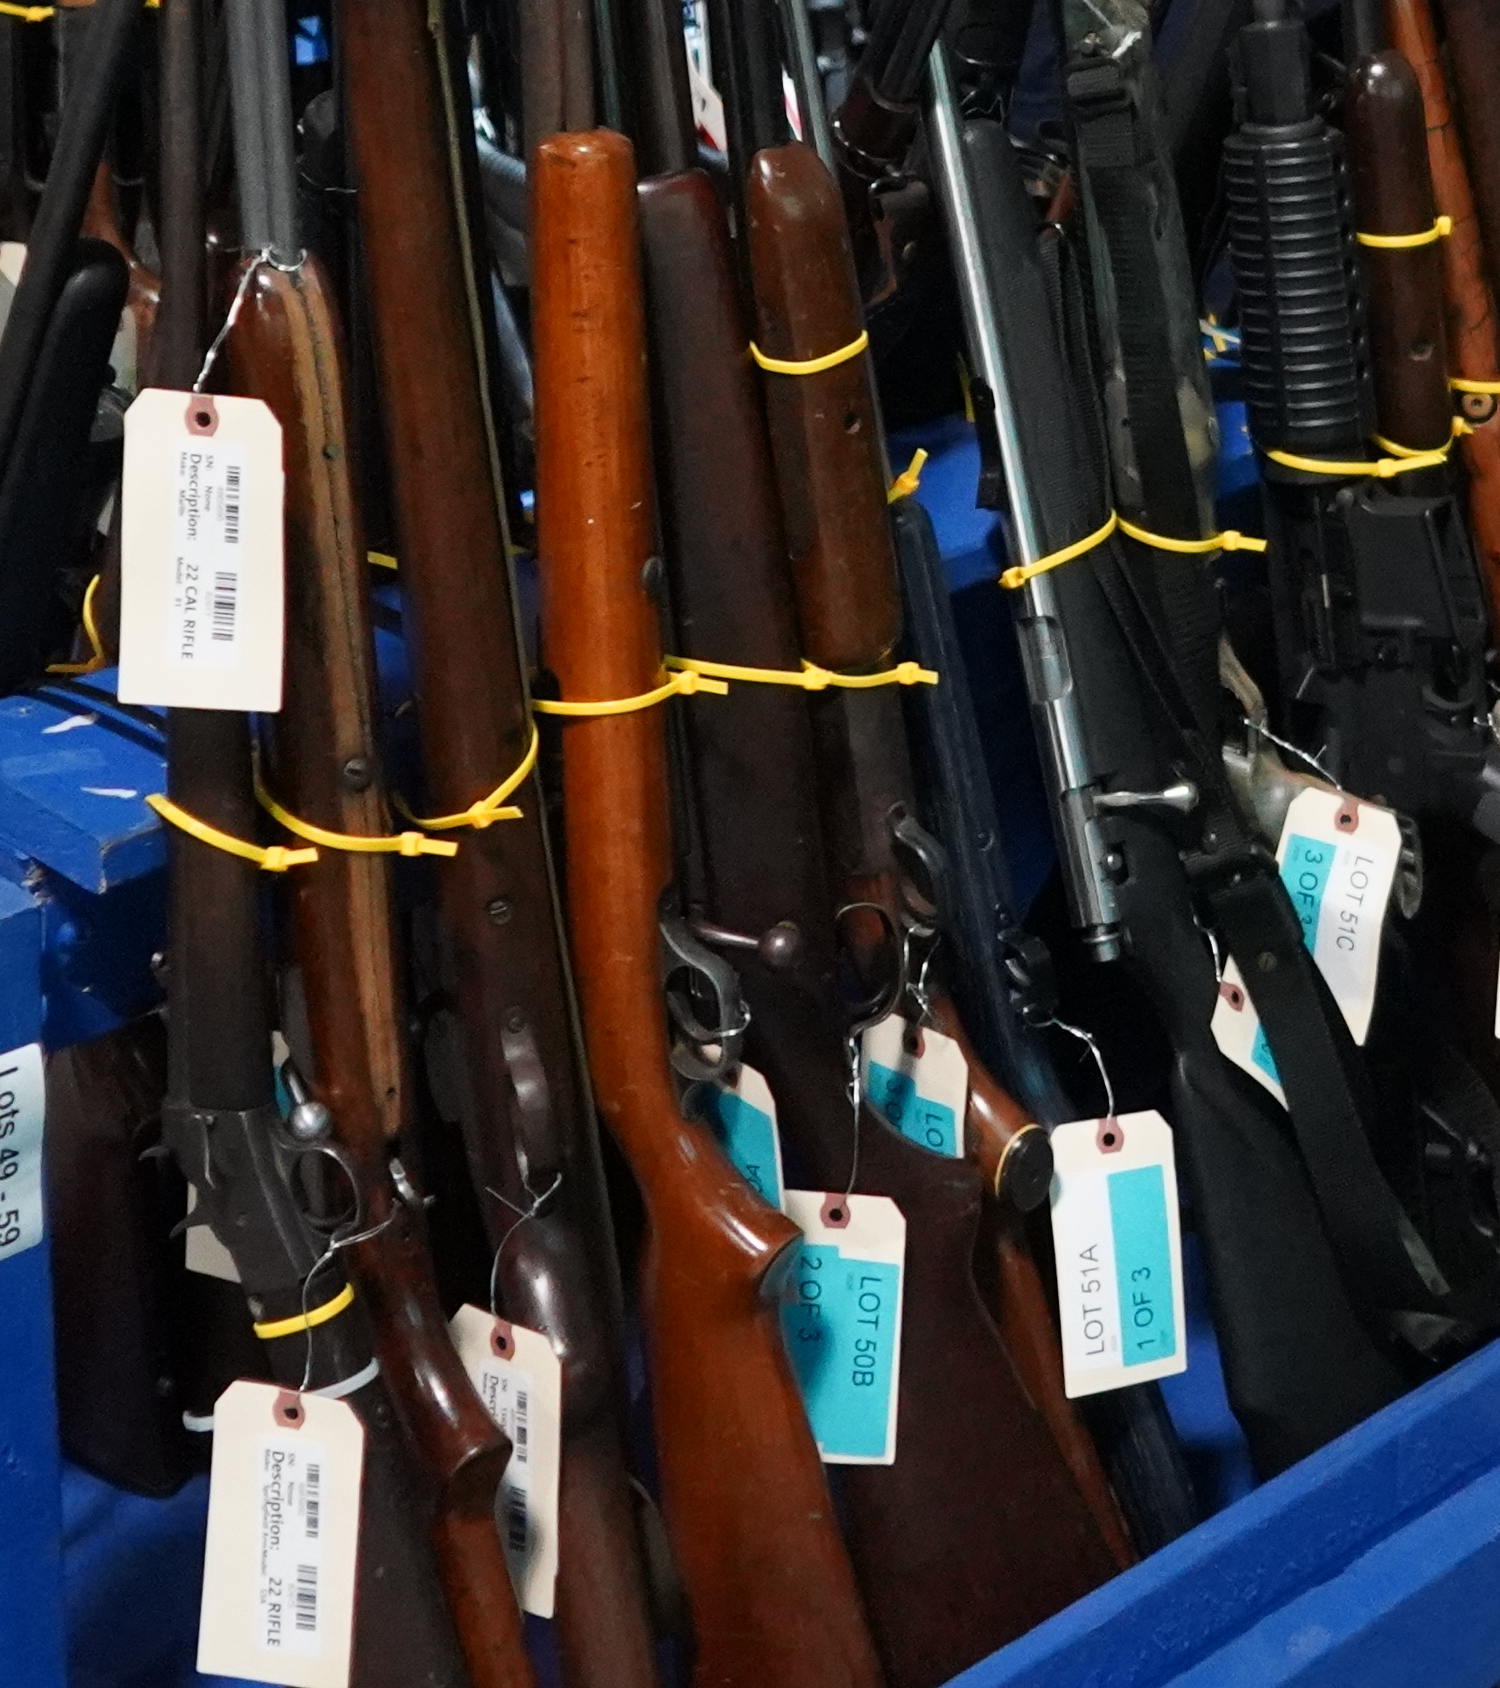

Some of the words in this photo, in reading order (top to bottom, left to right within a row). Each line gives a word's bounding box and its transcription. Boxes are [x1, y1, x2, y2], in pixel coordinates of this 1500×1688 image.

[185, 453, 202, 540] Description:
[204, 485, 213, 511] None
[186, 564, 198, 581] 22
[184, 586, 198, 613] CAL
[181, 619, 196, 659] RIFLE
[1305, 850, 1323, 864] 3
[1297, 872, 1318, 908] OF
[1345, 856, 1374, 907] LOT
[1336, 910, 1359, 951] 51C
[925, 1113, 944, 1149] LO
[0, 1191, 6, 1201] -
[801, 1256, 823, 1271] 2
[1080, 1244, 1101, 1294] 51A
[1131, 1267, 1151, 1282] 3
[800, 1280, 822, 1318] OF
[857, 1276, 882, 1332] LOT
[1132, 1292, 1154, 1328] OF
[799, 1329, 821, 1342] 3
[1082, 1304, 1105, 1356] LOT
[1137, 1339, 1156, 1350] 1
[852, 1338, 877, 1387] 50B
[269, 1451, 285, 1550] Description:
[268, 1577, 282, 1596] 22
[267, 1603, 281, 1647] RIFLE
